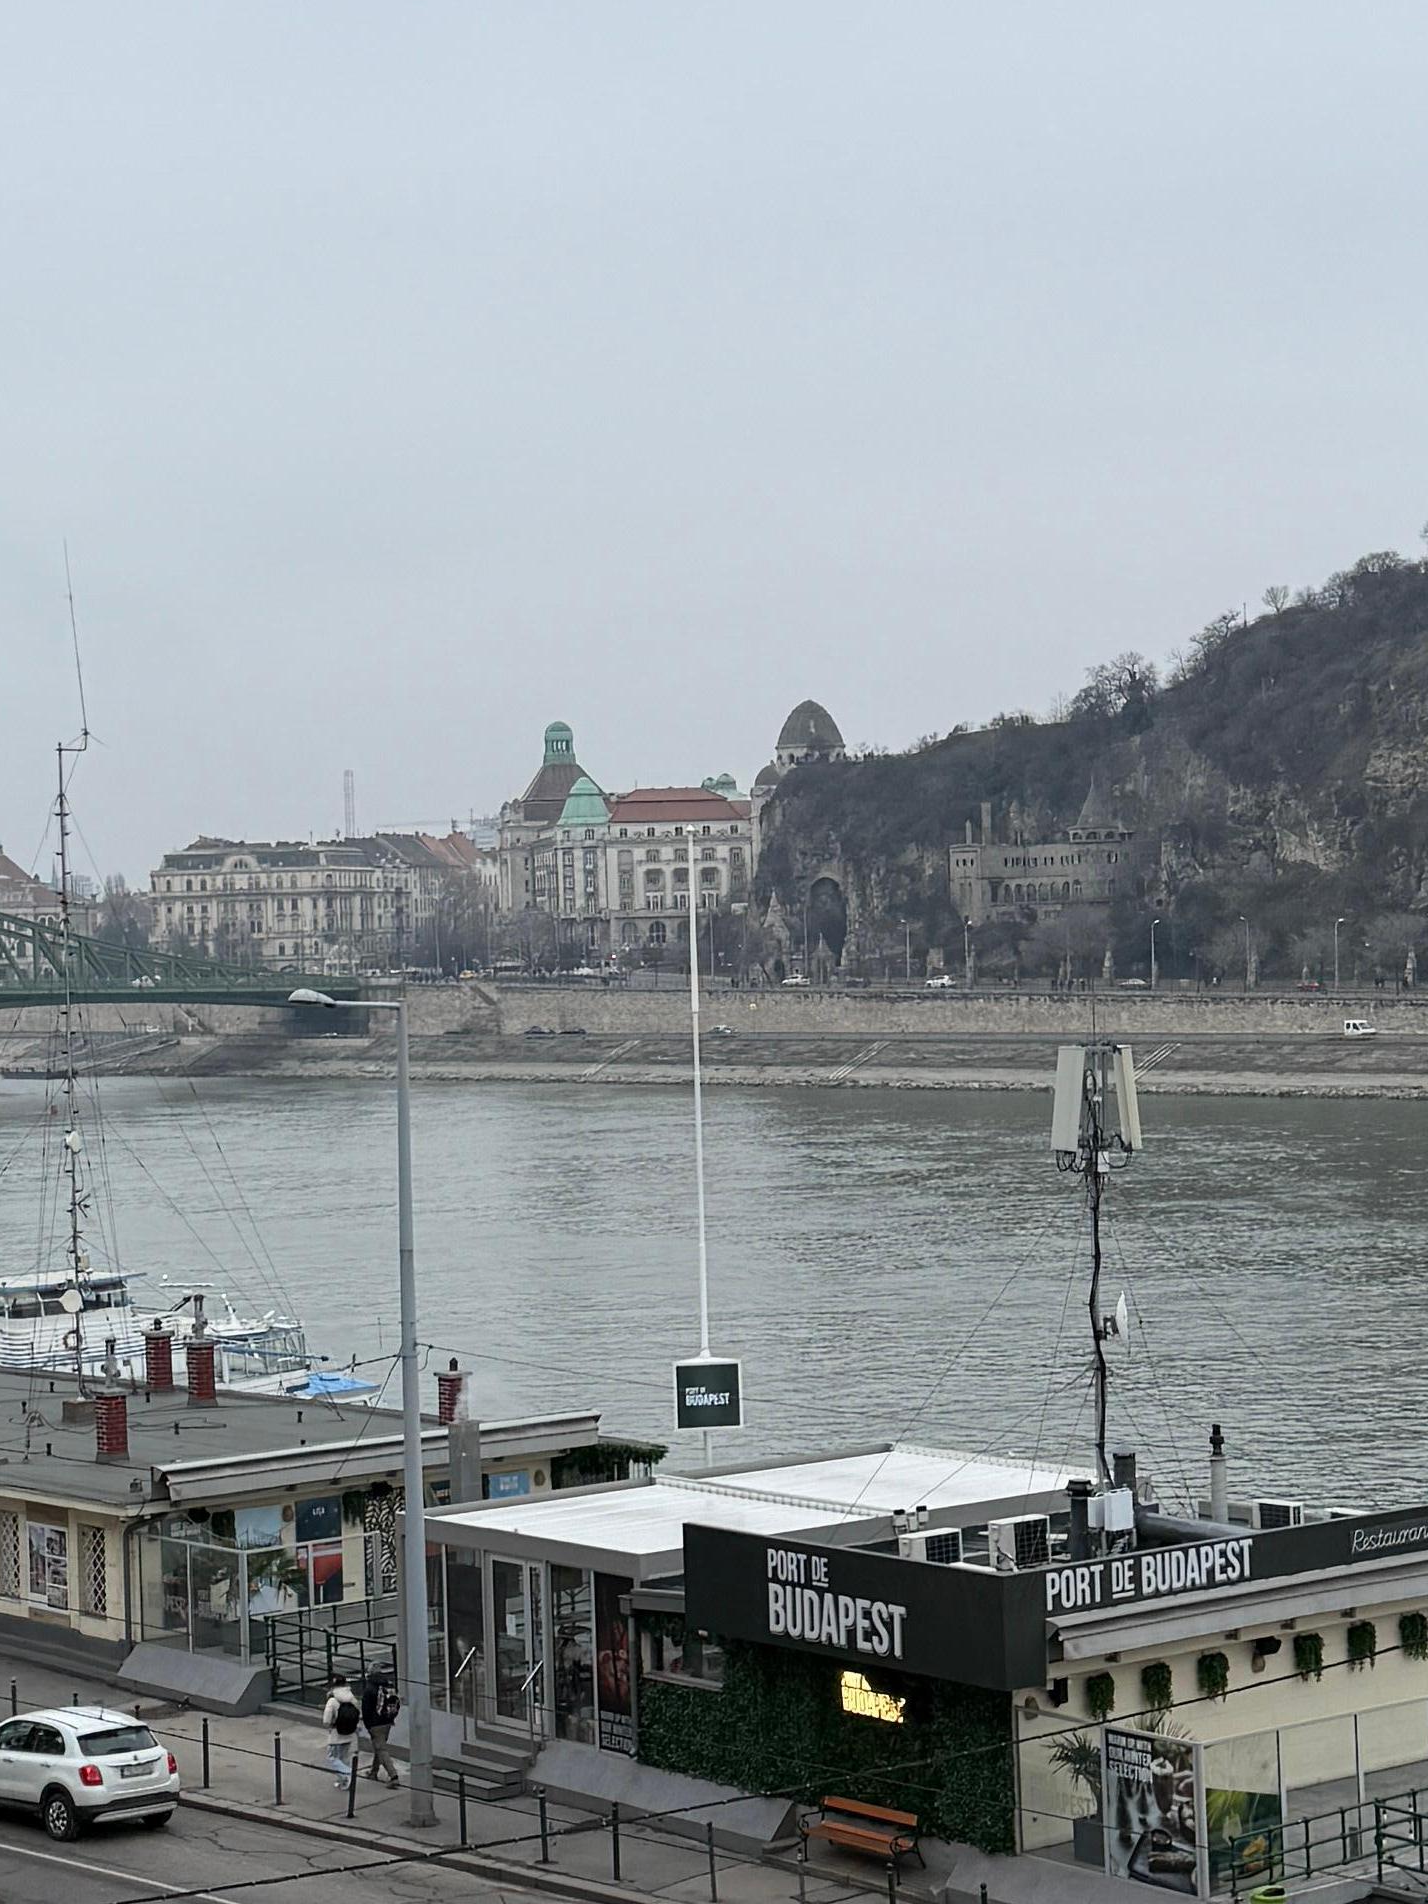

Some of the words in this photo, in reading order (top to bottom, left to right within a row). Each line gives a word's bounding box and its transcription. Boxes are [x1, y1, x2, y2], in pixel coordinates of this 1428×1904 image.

[685, 1392, 730, 1406] BUDAPEST
[767, 1548, 808, 1585] PORT
[811, 1556, 829, 1588] DE
[1046, 1564, 1104, 1611] PORT
[1111, 1559, 1135, 1599] DE
[1140, 1538, 1253, 1597] BUDAPEST
[768, 1582, 907, 1659] BUDAPEST
[1108, 1760, 1153, 1784] SELECTION
